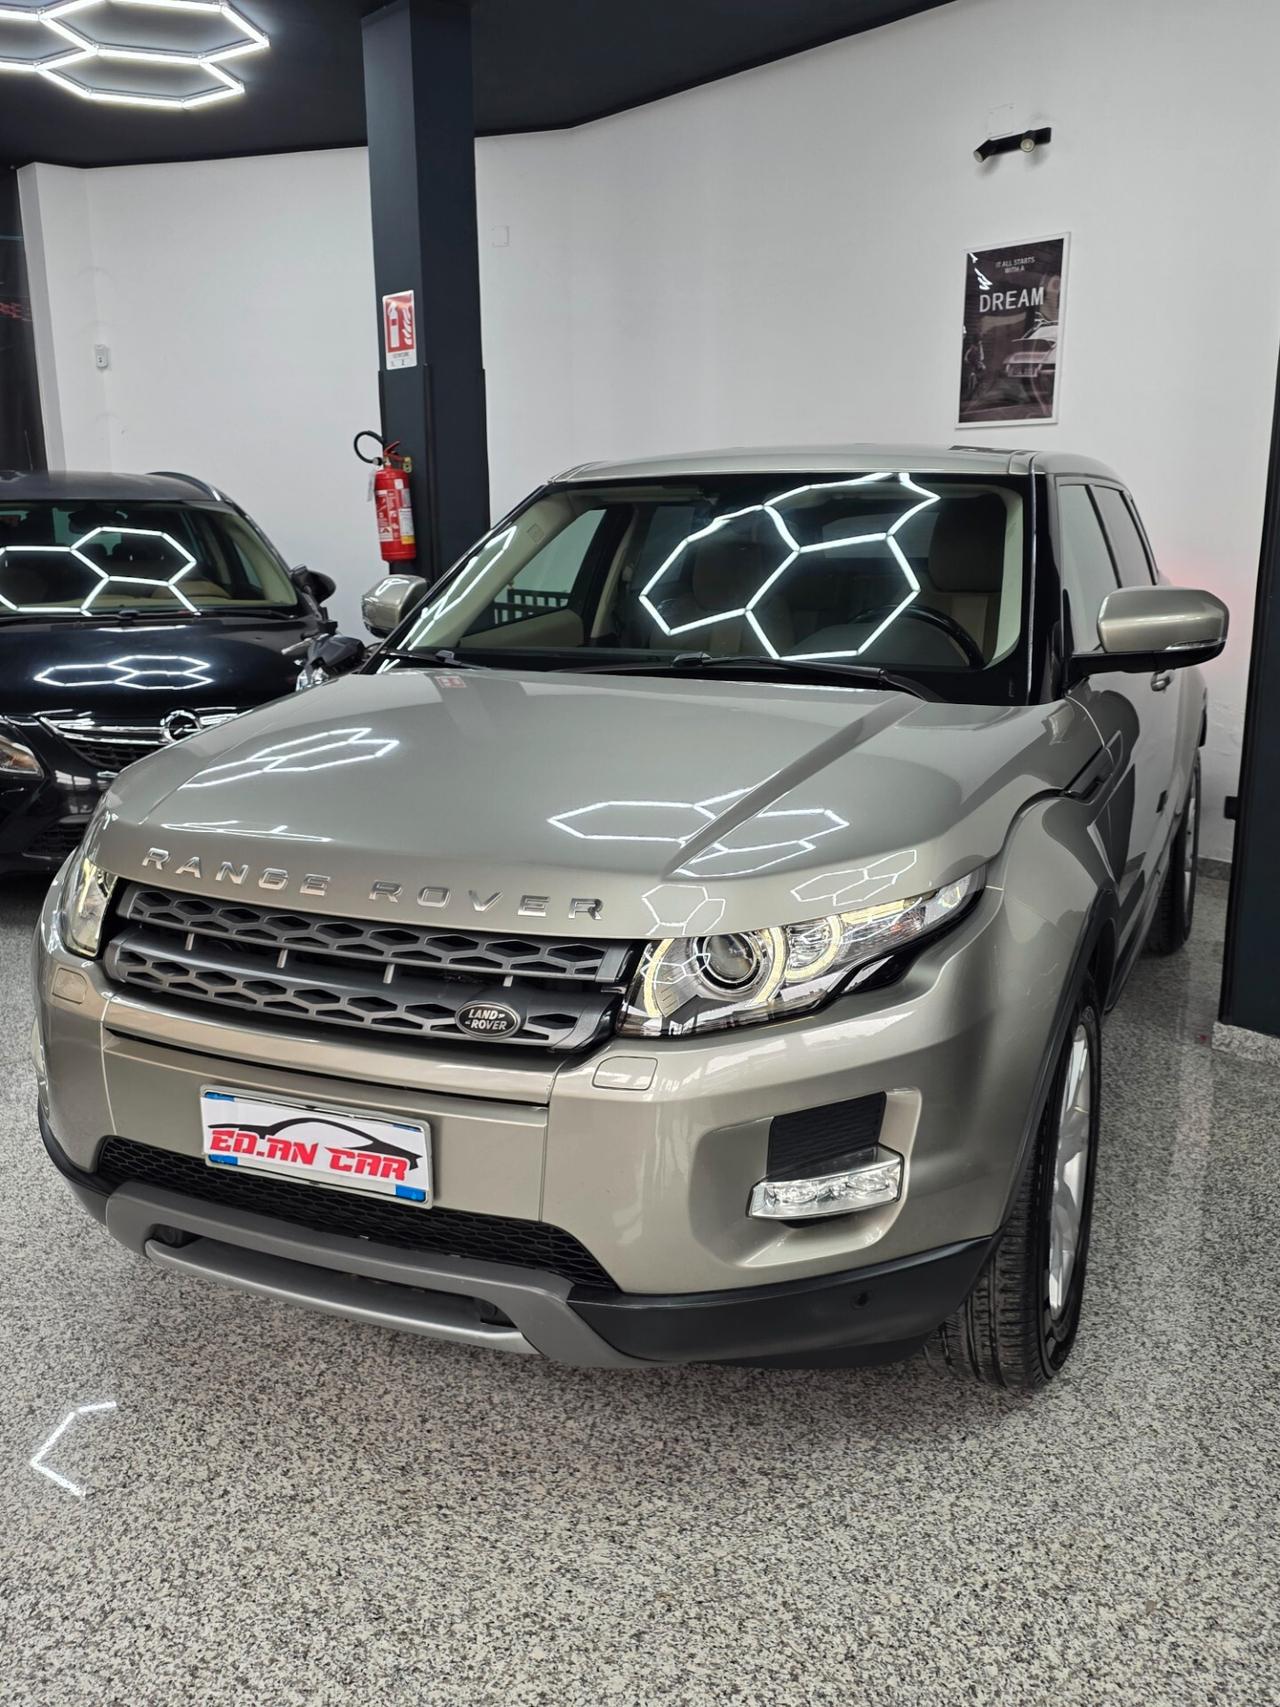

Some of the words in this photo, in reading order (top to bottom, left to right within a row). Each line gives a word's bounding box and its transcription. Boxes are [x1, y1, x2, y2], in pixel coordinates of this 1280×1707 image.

[1002, 259, 1012, 267] ALL
[1014, 256, 1035, 265] STARTS
[979, 286, 1044, 313] DREAM
[141, 847, 332, 897] RANGE
[367, 879, 604, 921] ROVER
[468, 1008, 499, 1020] LAND
[470, 1019, 508, 1031] ROVER
[209, 1129, 319, 1166] ED.AN
[324, 1146, 409, 1182] CAR
